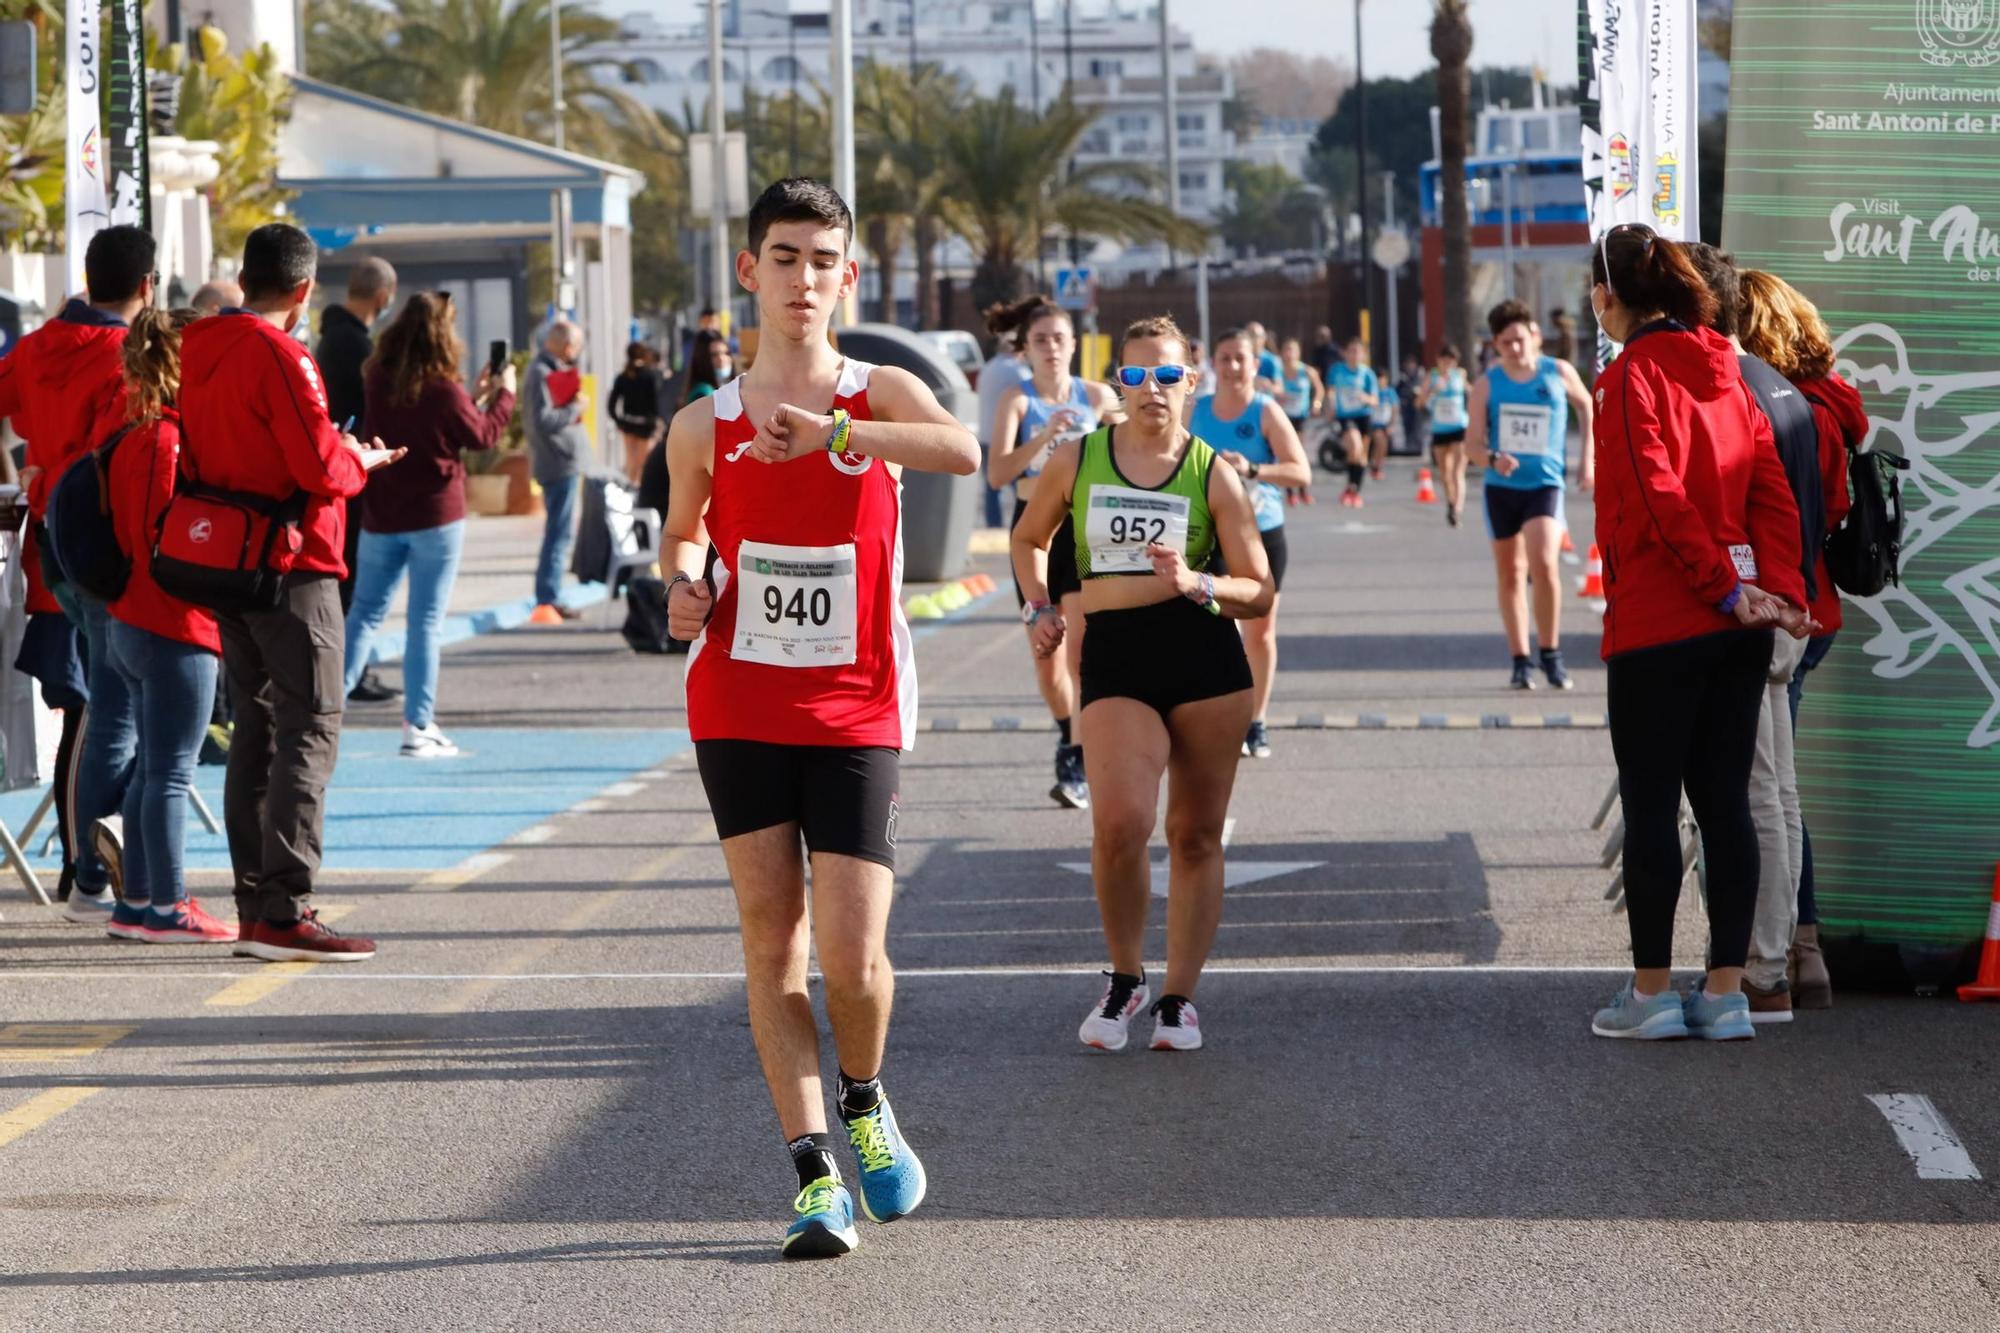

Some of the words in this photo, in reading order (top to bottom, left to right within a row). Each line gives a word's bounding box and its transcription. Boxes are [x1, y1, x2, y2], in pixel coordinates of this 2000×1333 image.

[1813, 110, 1861, 131] Sant
[1867, 111, 1949, 132] Antoni
[1954, 112, 1984, 133] de
[1862, 197, 1900, 215] Visit
[1823, 202, 1923, 265] Sant
[1967, 265, 1991, 281] de
[1511, 420, 1538, 437] 941
[1110, 516, 1166, 545] 952
[764, 585, 831, 626] 940
